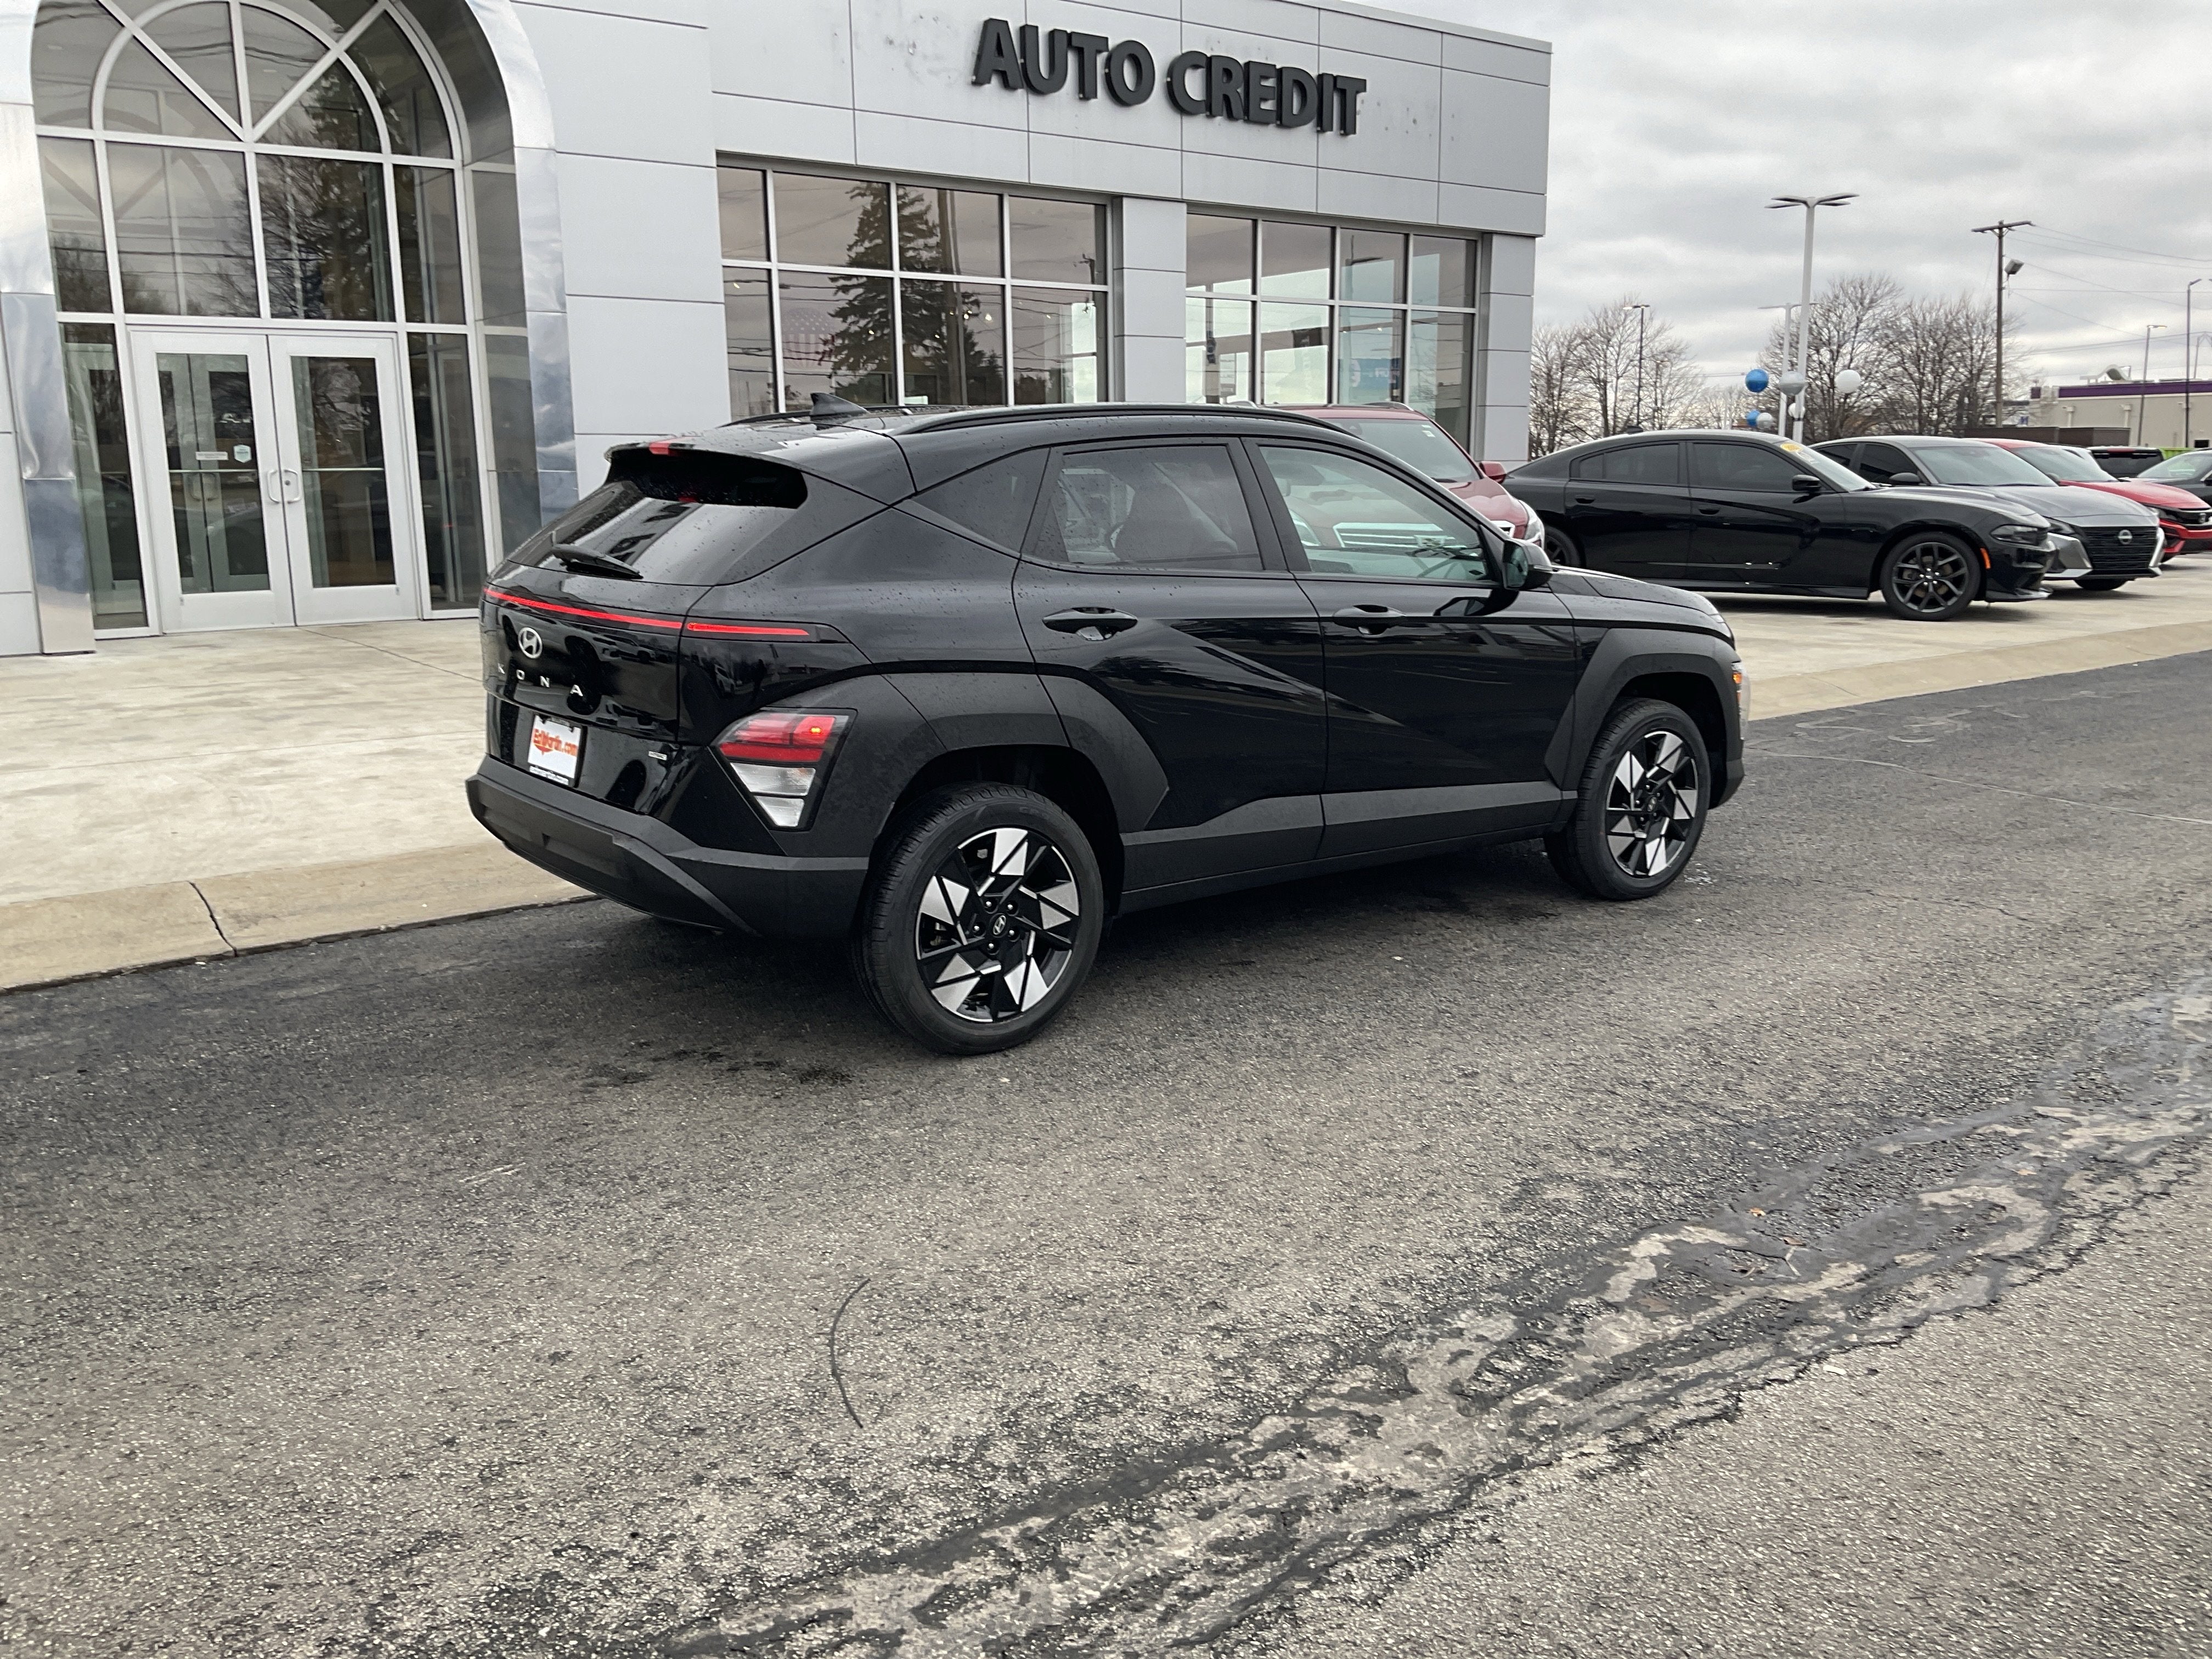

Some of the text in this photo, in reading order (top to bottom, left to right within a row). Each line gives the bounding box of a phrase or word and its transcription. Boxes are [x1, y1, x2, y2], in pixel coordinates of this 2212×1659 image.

[972, 18, 1367, 135] AUTO CREDIT
[497, 663, 583, 697] KONA
